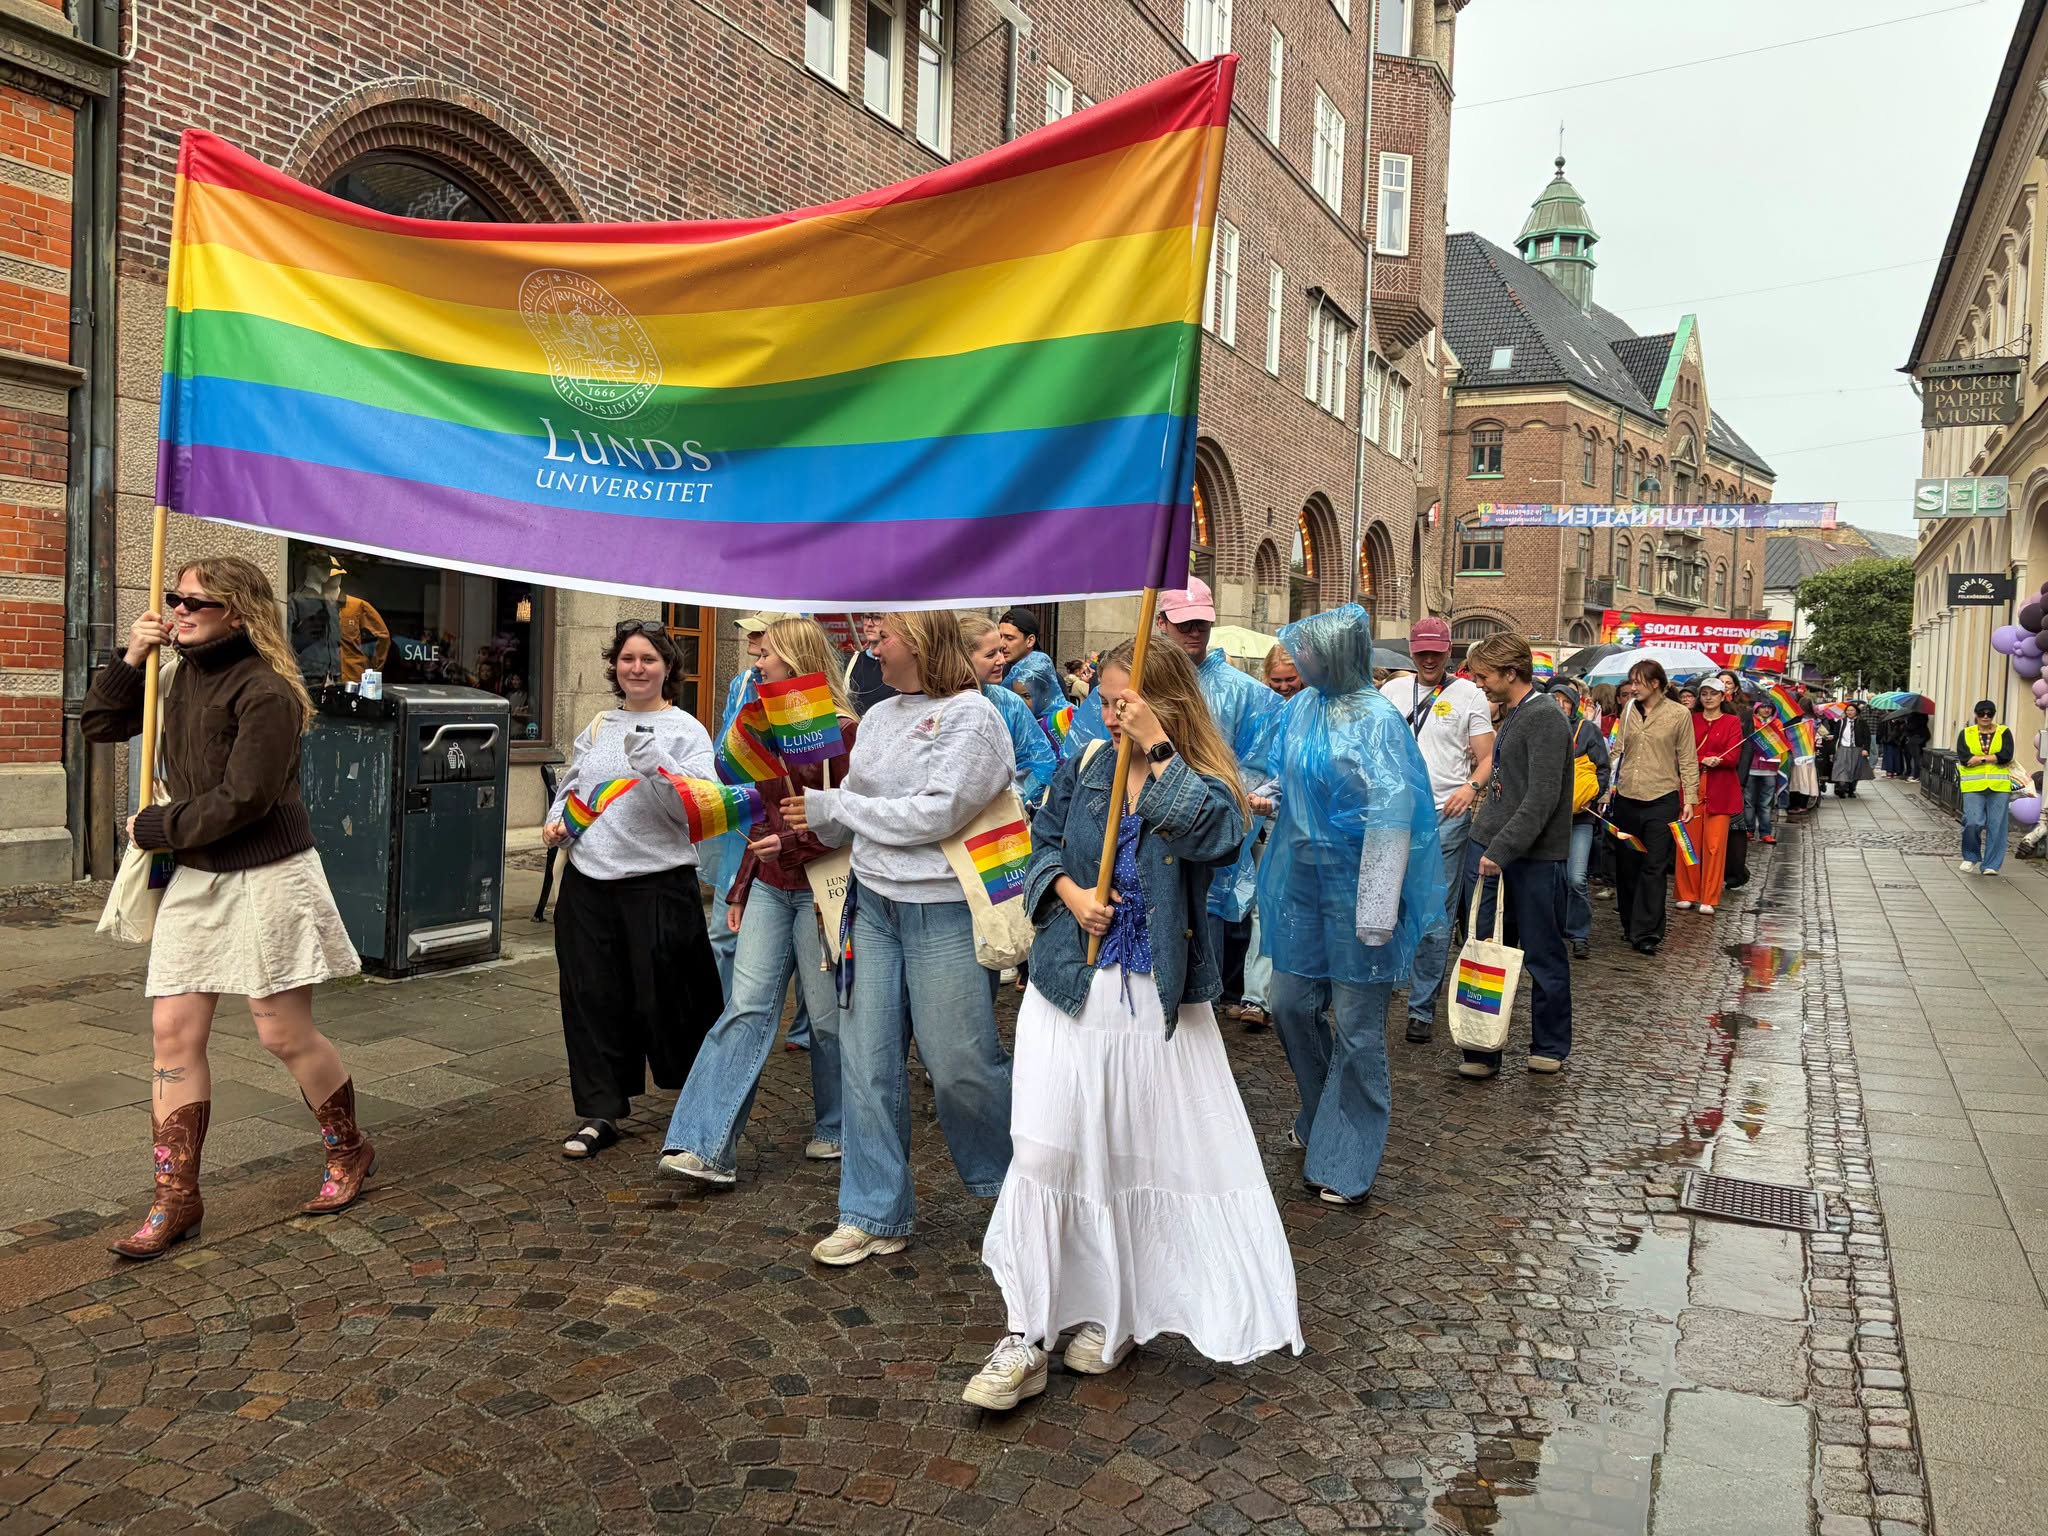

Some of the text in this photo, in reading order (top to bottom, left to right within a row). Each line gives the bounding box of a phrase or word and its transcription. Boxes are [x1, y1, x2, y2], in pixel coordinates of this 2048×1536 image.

[588, 387, 616, 397] 1666
[1928, 375, 2012, 393] BÖCKER
[1935, 391, 2006, 409] PAPPER
[1935, 407, 2003, 424] MUSIK
[539, 416, 712, 472] LUNDS
[535, 468, 713, 503] UNIVERSITET
[1916, 484, 2006, 511] SEB
[1958, 578, 1995, 593] TORA VEGA
[1644, 623, 1779, 641] SOCIAL SCIENCES
[404, 644, 439, 661] SALE
[1644, 640, 1776, 658] STUDENT UNION
[783, 729, 823, 747] LUNDS
